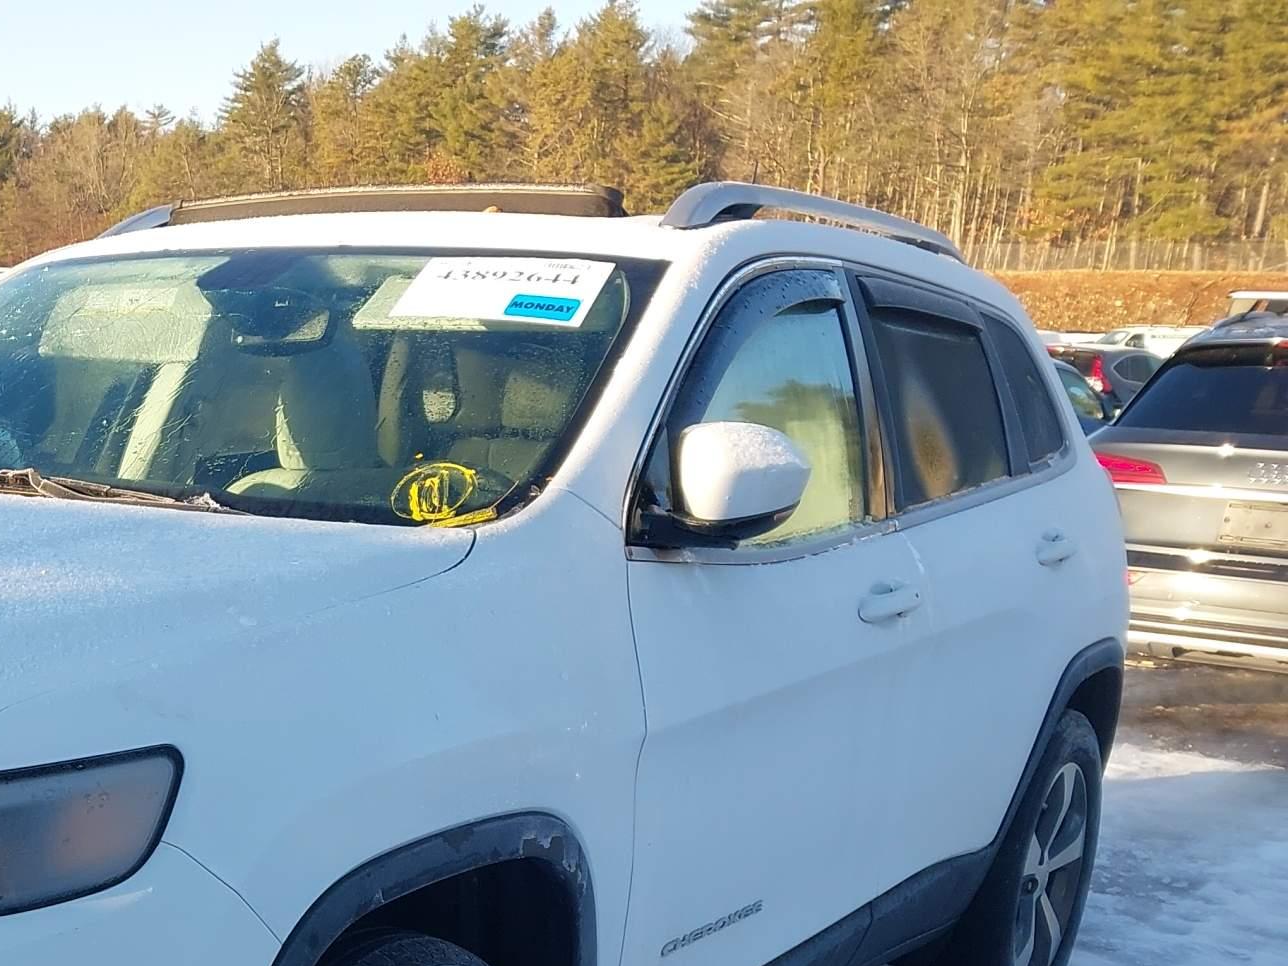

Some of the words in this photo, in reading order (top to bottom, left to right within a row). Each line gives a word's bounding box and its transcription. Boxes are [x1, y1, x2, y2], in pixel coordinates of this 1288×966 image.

[437, 269, 580, 285] 43892644
[511, 300, 575, 314] MONDAY
[660, 899, 763, 957] CHEROKEE
